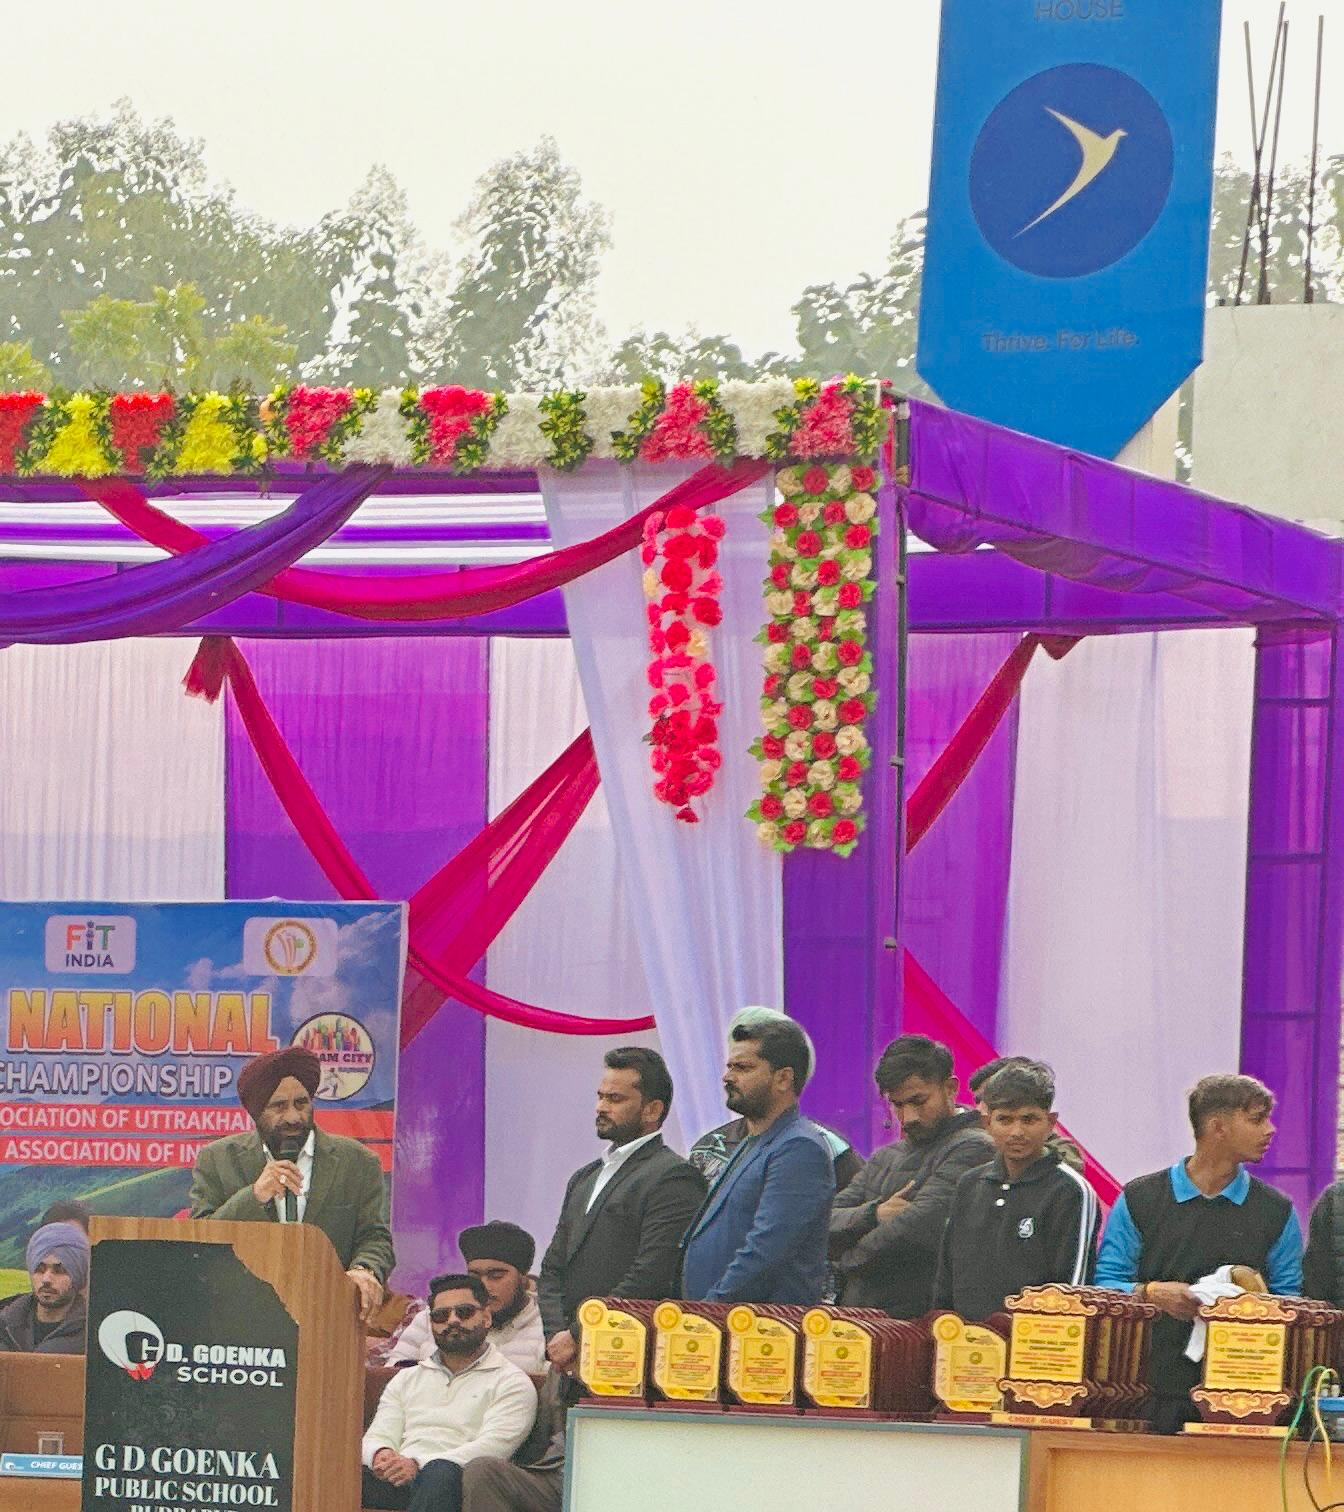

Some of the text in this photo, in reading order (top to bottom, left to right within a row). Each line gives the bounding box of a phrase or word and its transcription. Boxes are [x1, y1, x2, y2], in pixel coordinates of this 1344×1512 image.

[1034, 0, 1124, 21] HOUSE
[983, 330, 1140, 351] Thrive. For Life.
[65, 954, 114, 968] INDIA
[7, 988, 280, 1057] NATIONAL
[343, 1053, 373, 1063] CITY
[101, 1109, 130, 1129] OF
[4, 1140, 141, 1162] ASSOCIATION
[146, 1142, 175, 1162] OF
[193, 1344, 286, 1368] GOENKA
[177, 1366, 283, 1387] SCHOOL
[1202, 1425, 1270, 1434] CHIEF GUEST
[95, 1444, 280, 1480] G D GOENKA
[94, 1476, 279, 1508] PUBLIC SCHOOL
